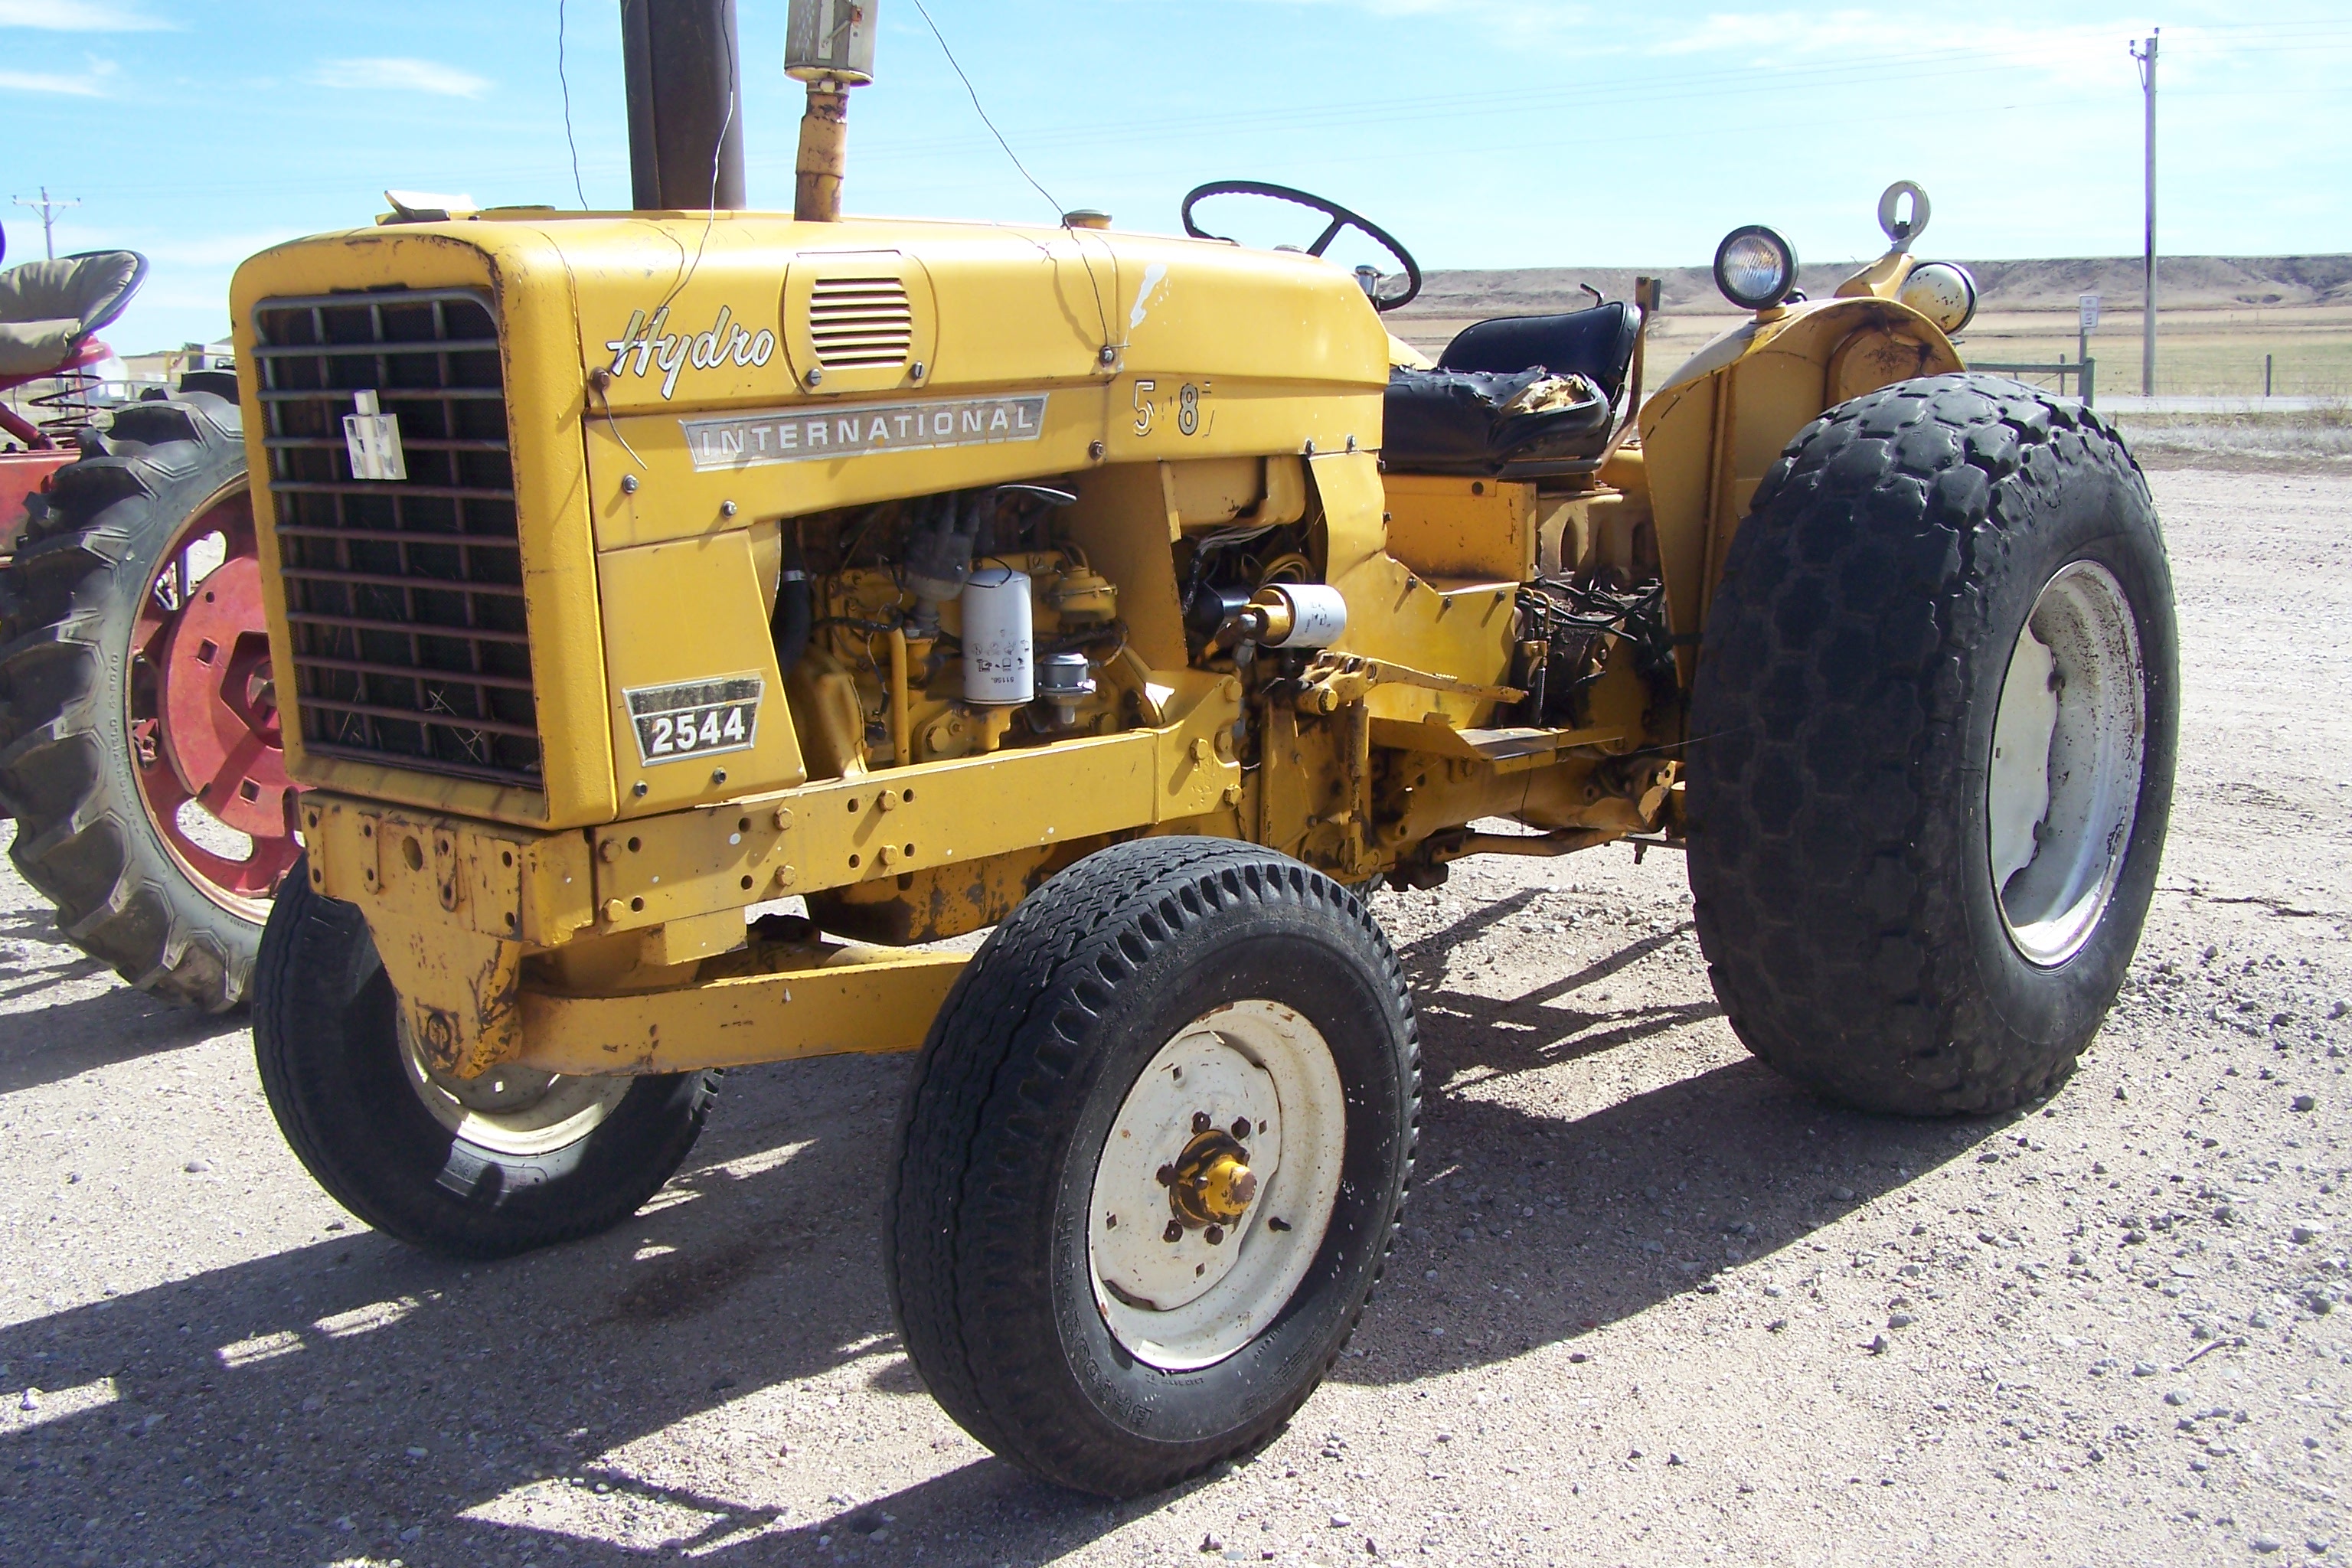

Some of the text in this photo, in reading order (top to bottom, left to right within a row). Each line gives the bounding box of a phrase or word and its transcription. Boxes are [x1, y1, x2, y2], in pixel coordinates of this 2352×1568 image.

[606, 305, 775, 400] Hydro
[701, 406, 1034, 457] INTERNATIONAL
[652, 707, 746, 754] 2544
